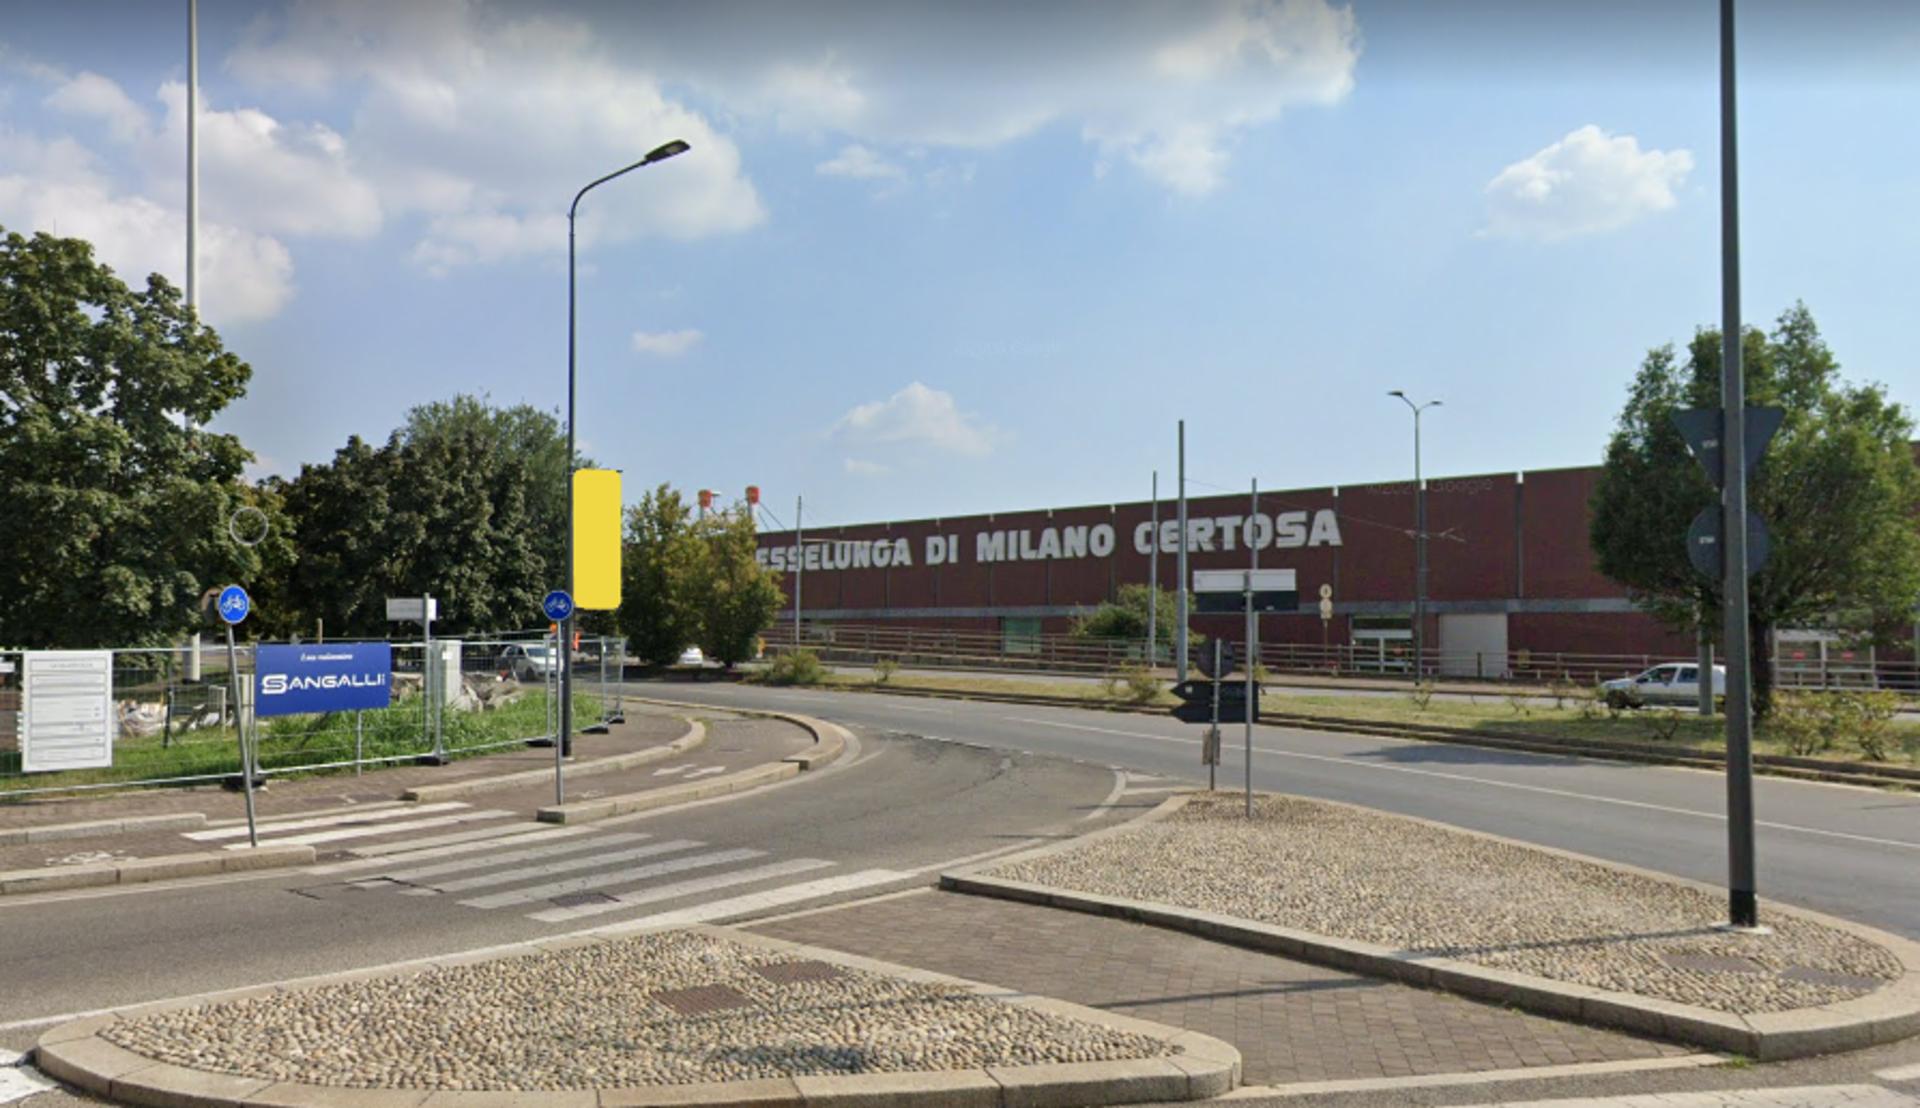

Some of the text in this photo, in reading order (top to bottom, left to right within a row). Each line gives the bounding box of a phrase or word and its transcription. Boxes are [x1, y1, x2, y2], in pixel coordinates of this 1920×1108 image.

[756, 509, 1343, 572] ESSELUNGA DI MILANO CERTOSA
[261, 673, 382, 695] SANGALLI
